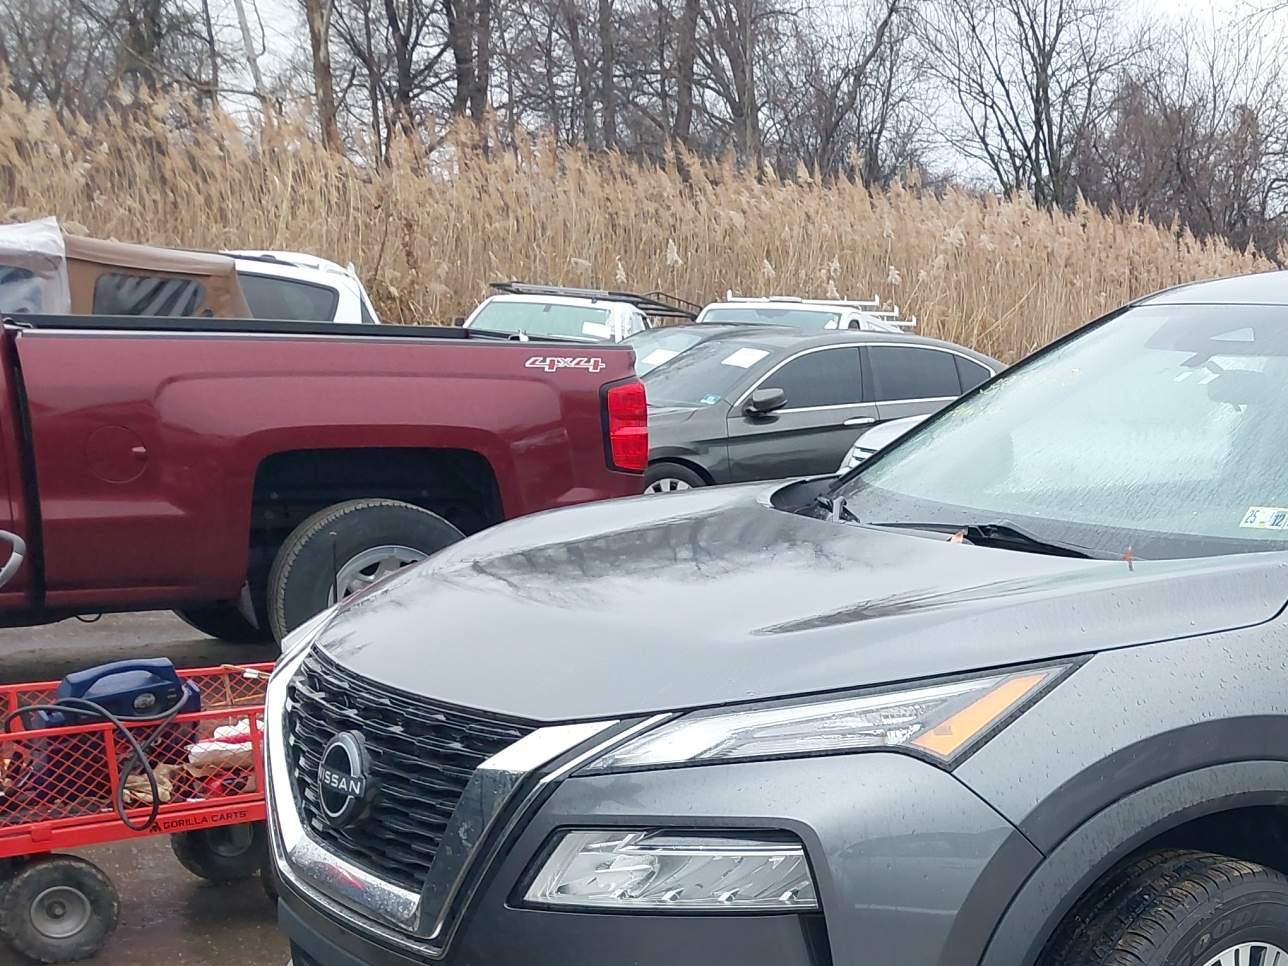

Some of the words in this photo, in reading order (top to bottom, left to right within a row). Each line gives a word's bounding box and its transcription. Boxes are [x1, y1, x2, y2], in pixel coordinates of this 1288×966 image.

[1245, 509, 1260, 524] 25
[163, 817, 208, 830] GORILLA
[211, 811, 248, 822] CARTS
